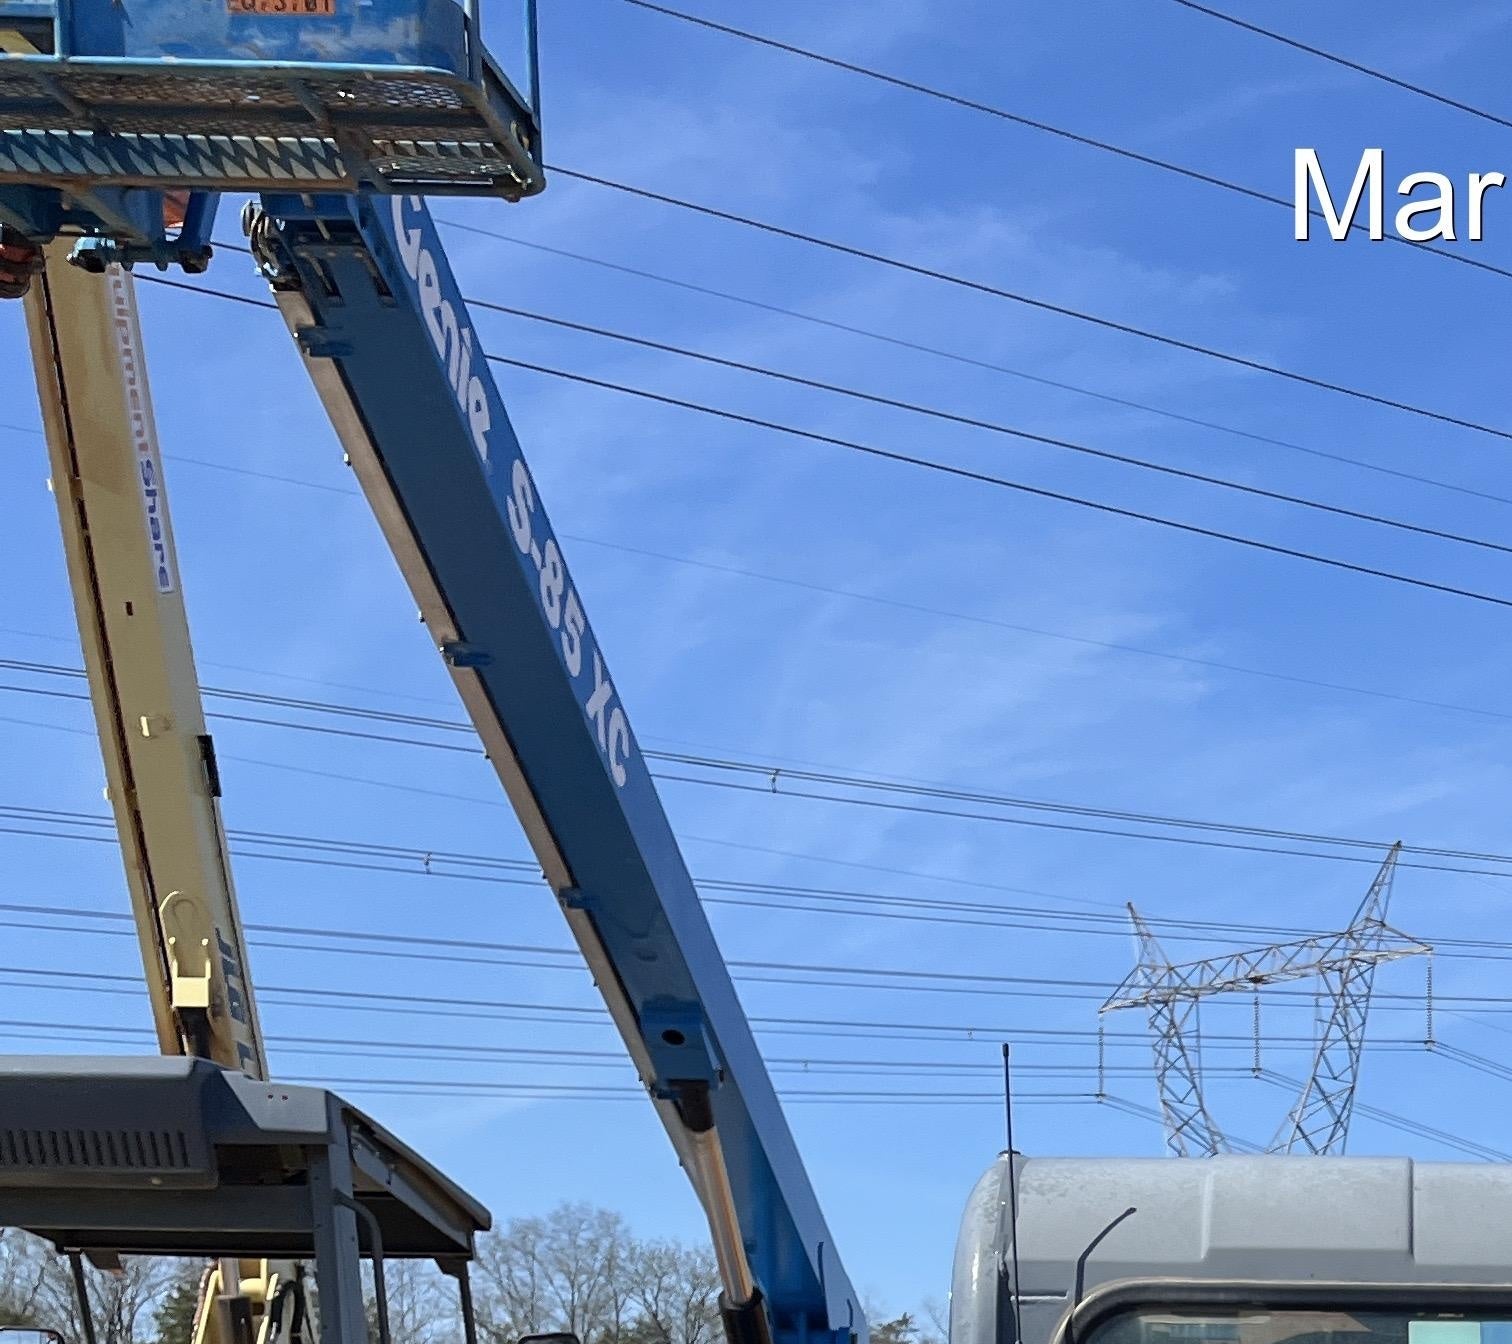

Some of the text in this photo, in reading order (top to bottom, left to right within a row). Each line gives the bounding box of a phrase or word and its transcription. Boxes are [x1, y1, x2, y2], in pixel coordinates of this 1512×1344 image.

[108, 262, 172, 589] uipmentShare
[391, 195, 491, 463] Genie
[506, 458, 630, 788] S-85 XC
